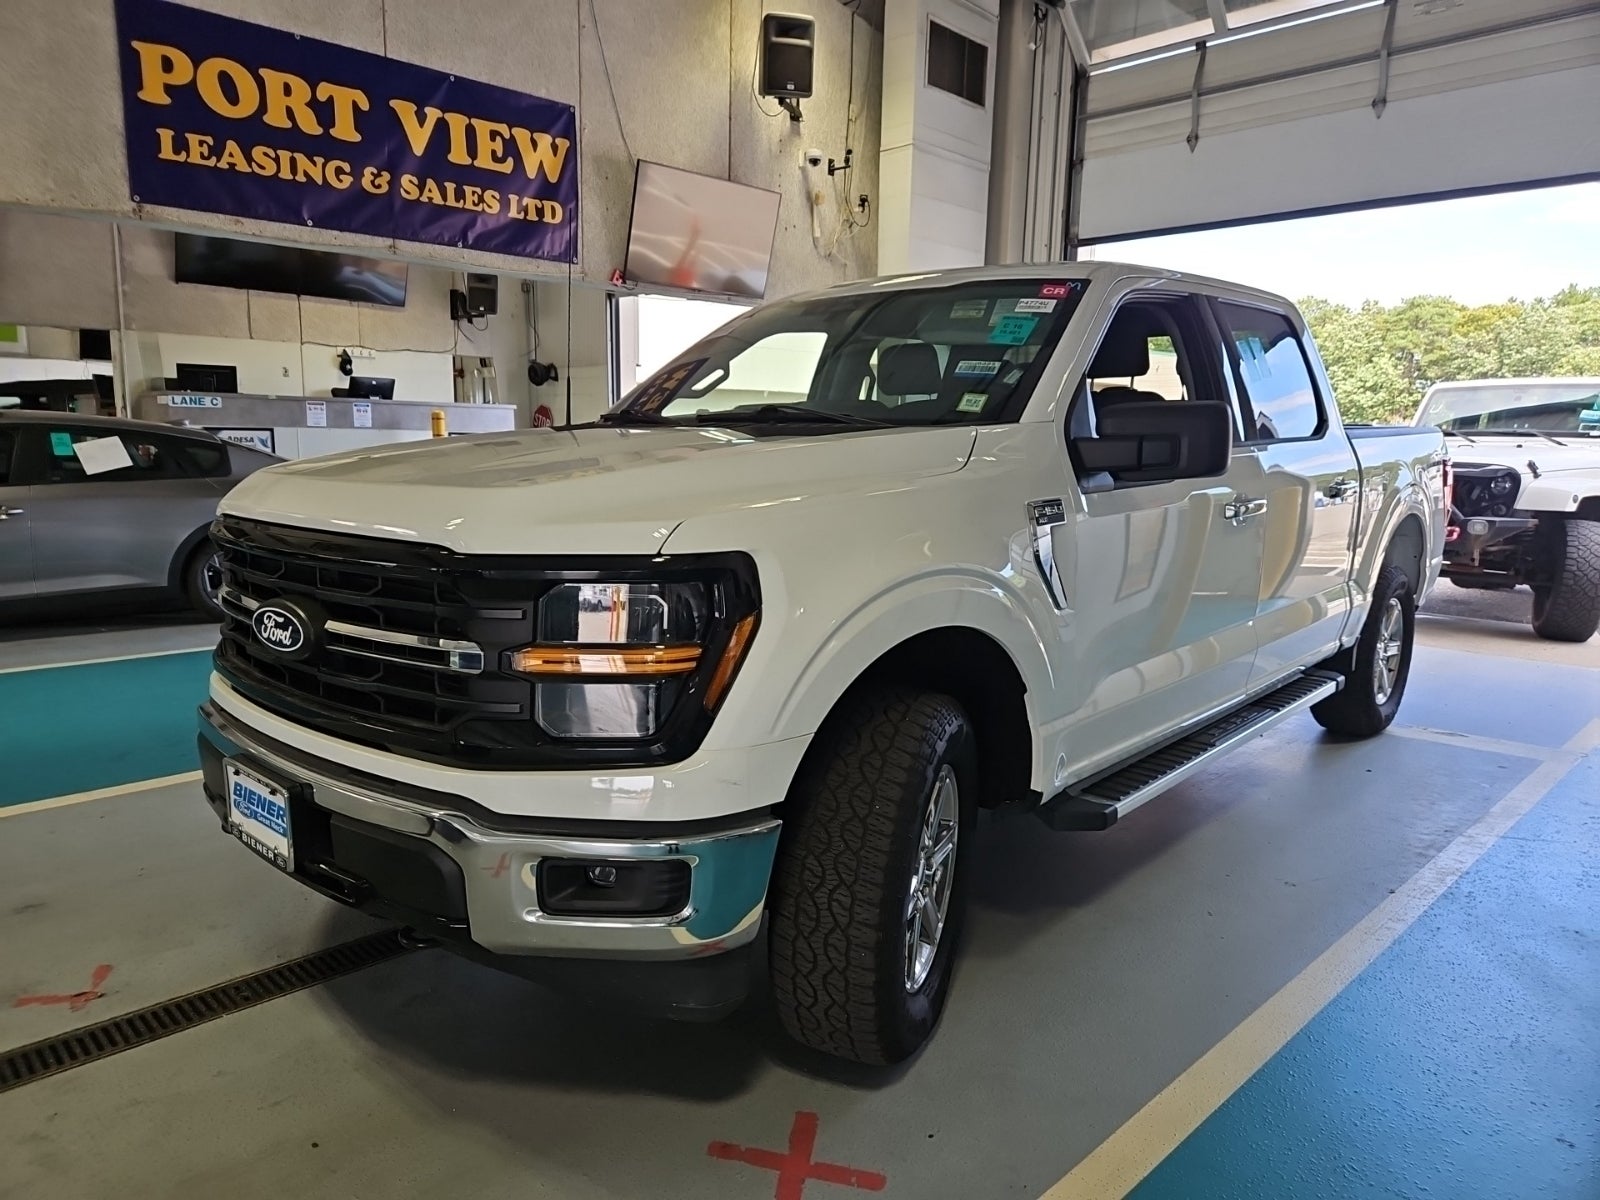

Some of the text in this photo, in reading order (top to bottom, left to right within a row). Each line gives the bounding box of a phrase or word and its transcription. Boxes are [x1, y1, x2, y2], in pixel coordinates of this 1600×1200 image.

[131, 40, 571, 185] PORT VIEW
[155, 127, 565, 225] LEASING & SALES LTD
[1043, 287, 1065, 295] CR
[171, 396, 219, 407] LANE C
[533, 413, 551, 427] STOP
[227, 435, 255, 443] ADESA
[261, 611, 292, 646] Ford
[233, 781, 287, 824] BIENER
[256, 813, 283, 833] Great Neck
[241, 833, 275, 861] BIENER
